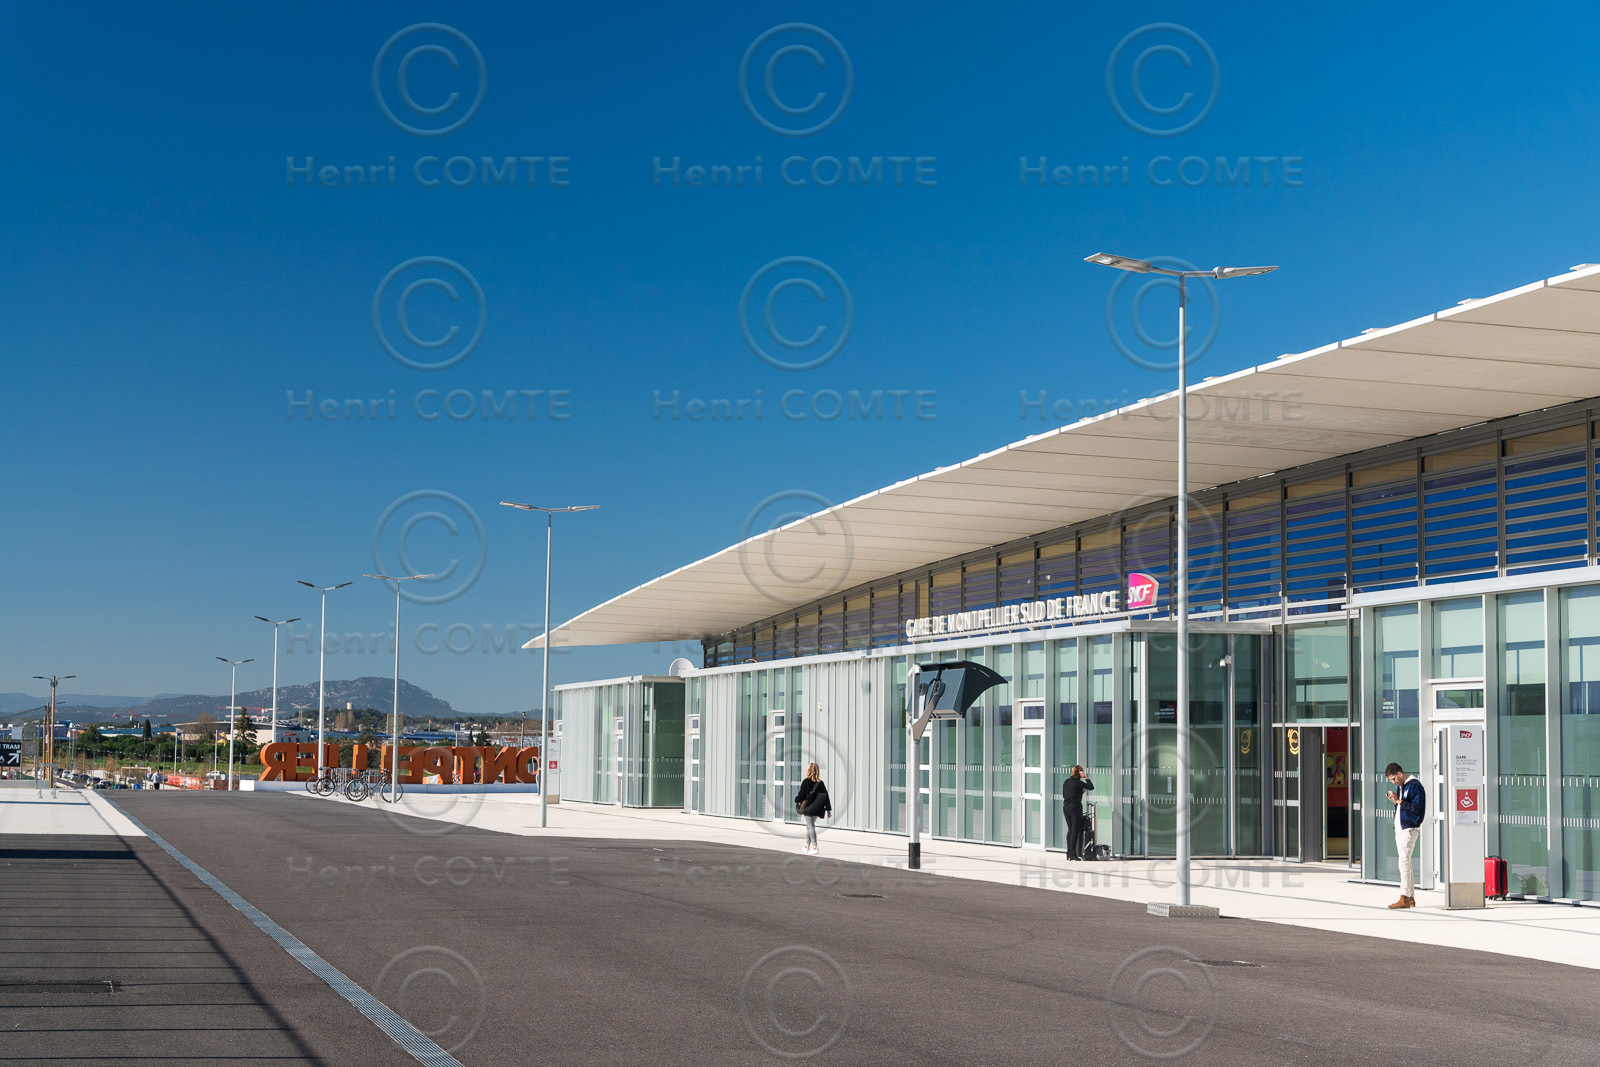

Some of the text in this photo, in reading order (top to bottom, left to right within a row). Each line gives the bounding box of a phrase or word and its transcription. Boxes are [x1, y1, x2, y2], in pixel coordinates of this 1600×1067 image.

[1127, 583, 1152, 604] SNCF
[905, 590, 1120, 637] GARE DE MONTPELLIER SUD DE FRANCE
